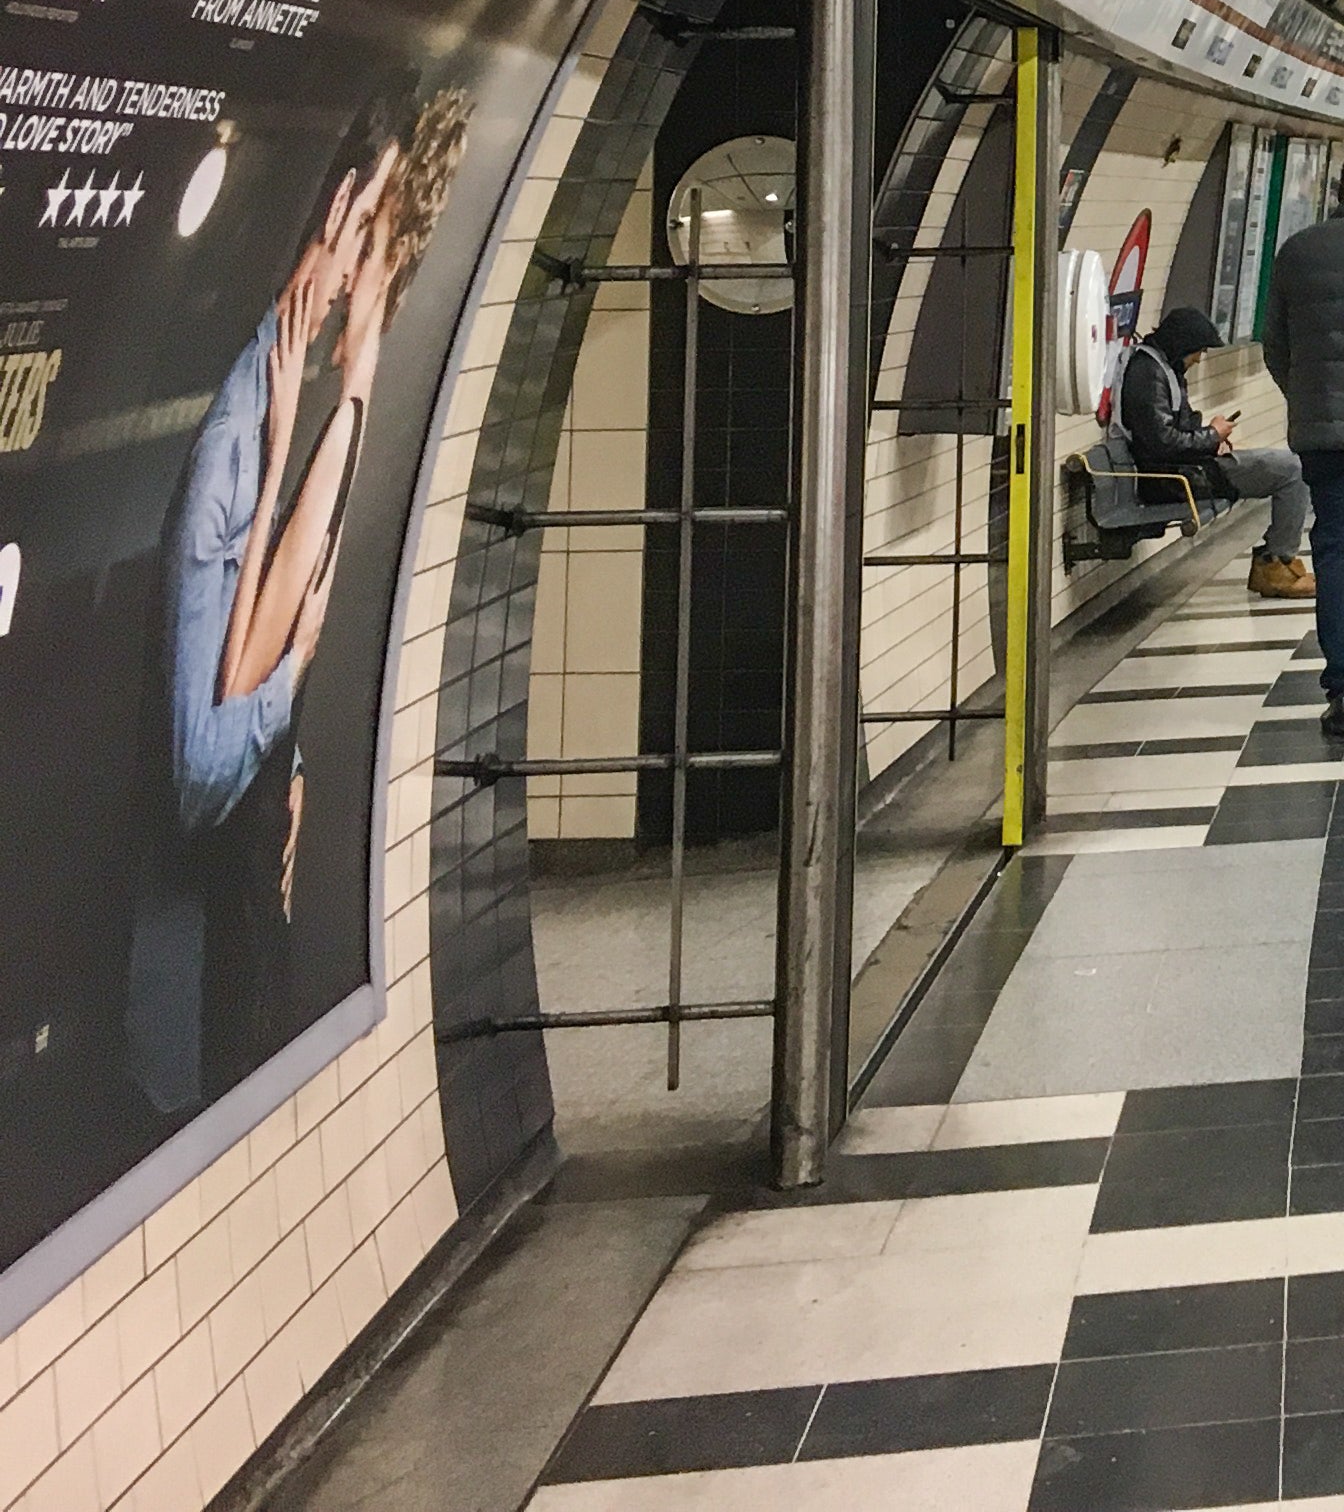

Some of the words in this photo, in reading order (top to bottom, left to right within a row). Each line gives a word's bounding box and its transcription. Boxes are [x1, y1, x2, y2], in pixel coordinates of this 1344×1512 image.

[69, 76, 118, 113] AND
[115, 81, 225, 121] TENDERNESS
[3, 113, 67, 151] LOVE
